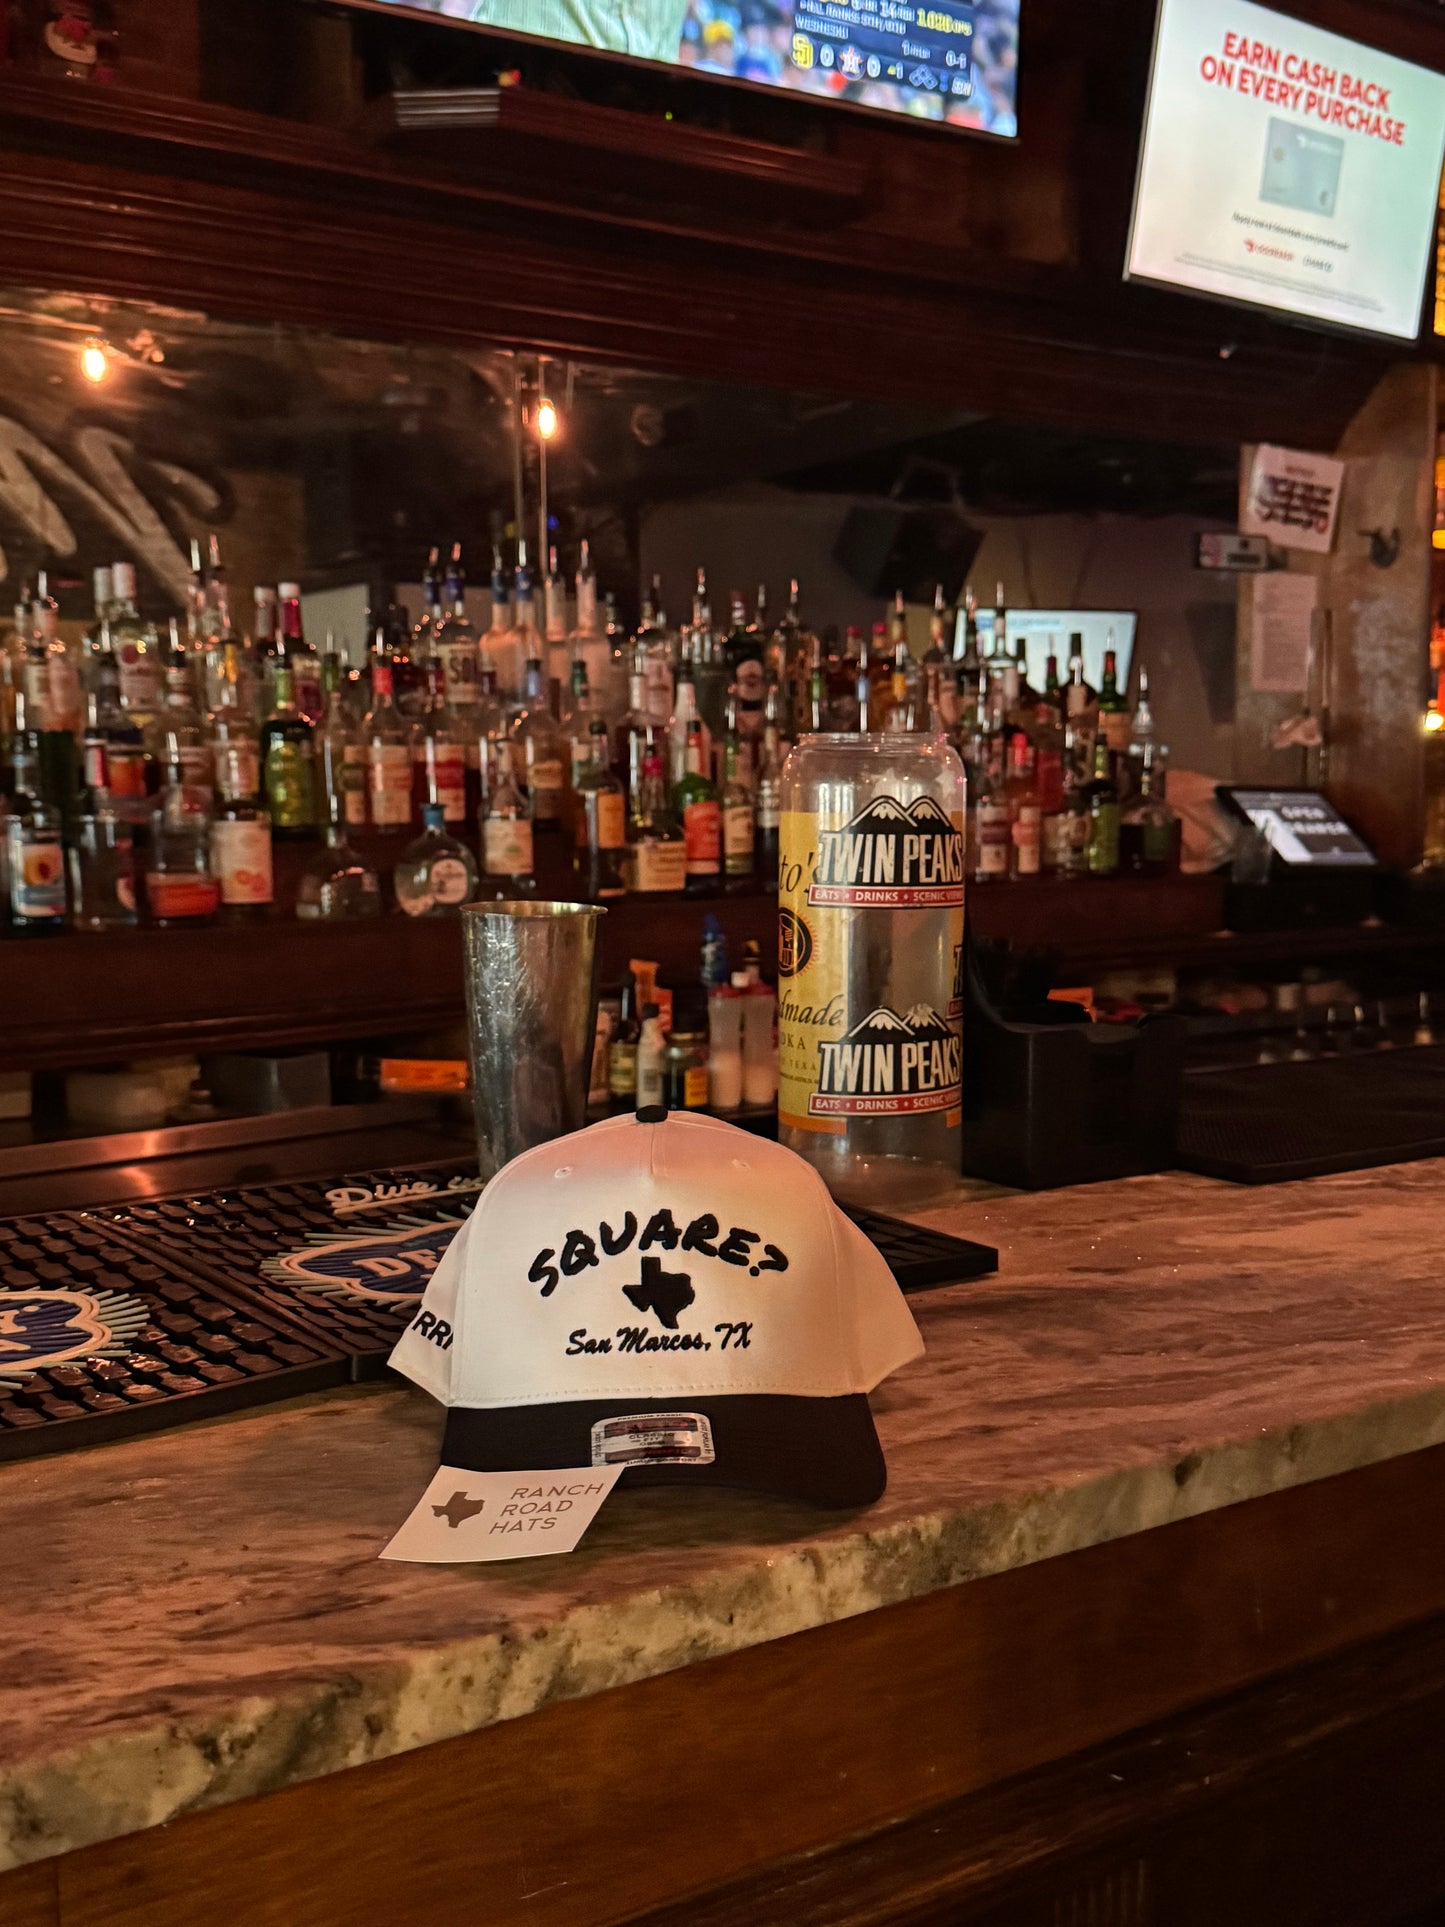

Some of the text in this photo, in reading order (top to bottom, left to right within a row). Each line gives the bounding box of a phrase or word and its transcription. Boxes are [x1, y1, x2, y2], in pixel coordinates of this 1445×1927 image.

[1223, 31, 1391, 112] EARN CASH BACK
[1200, 55, 1407, 146] ON EVERY PURCHASE
[820, 833, 963, 885] TWIN PEAKS
[814, 890, 840, 901] EATS
[855, 890, 899, 902] DRINKS
[913, 890, 945, 902] SCENIC
[820, 1036, 961, 1093] TWIN PEAKS
[815, 1098, 841, 1109] EATS
[856, 1099, 899, 1111] DRINKS
[912, 1094, 945, 1109] SCENIC
[527, 1208, 789, 1298] SQUARE?
[565, 1321, 754, 1356] San Marcos, TX
[500, 1500, 573, 1517] ROAD
[510, 1482, 604, 1500] RANCH
[489, 1517, 558, 1535] HATS
